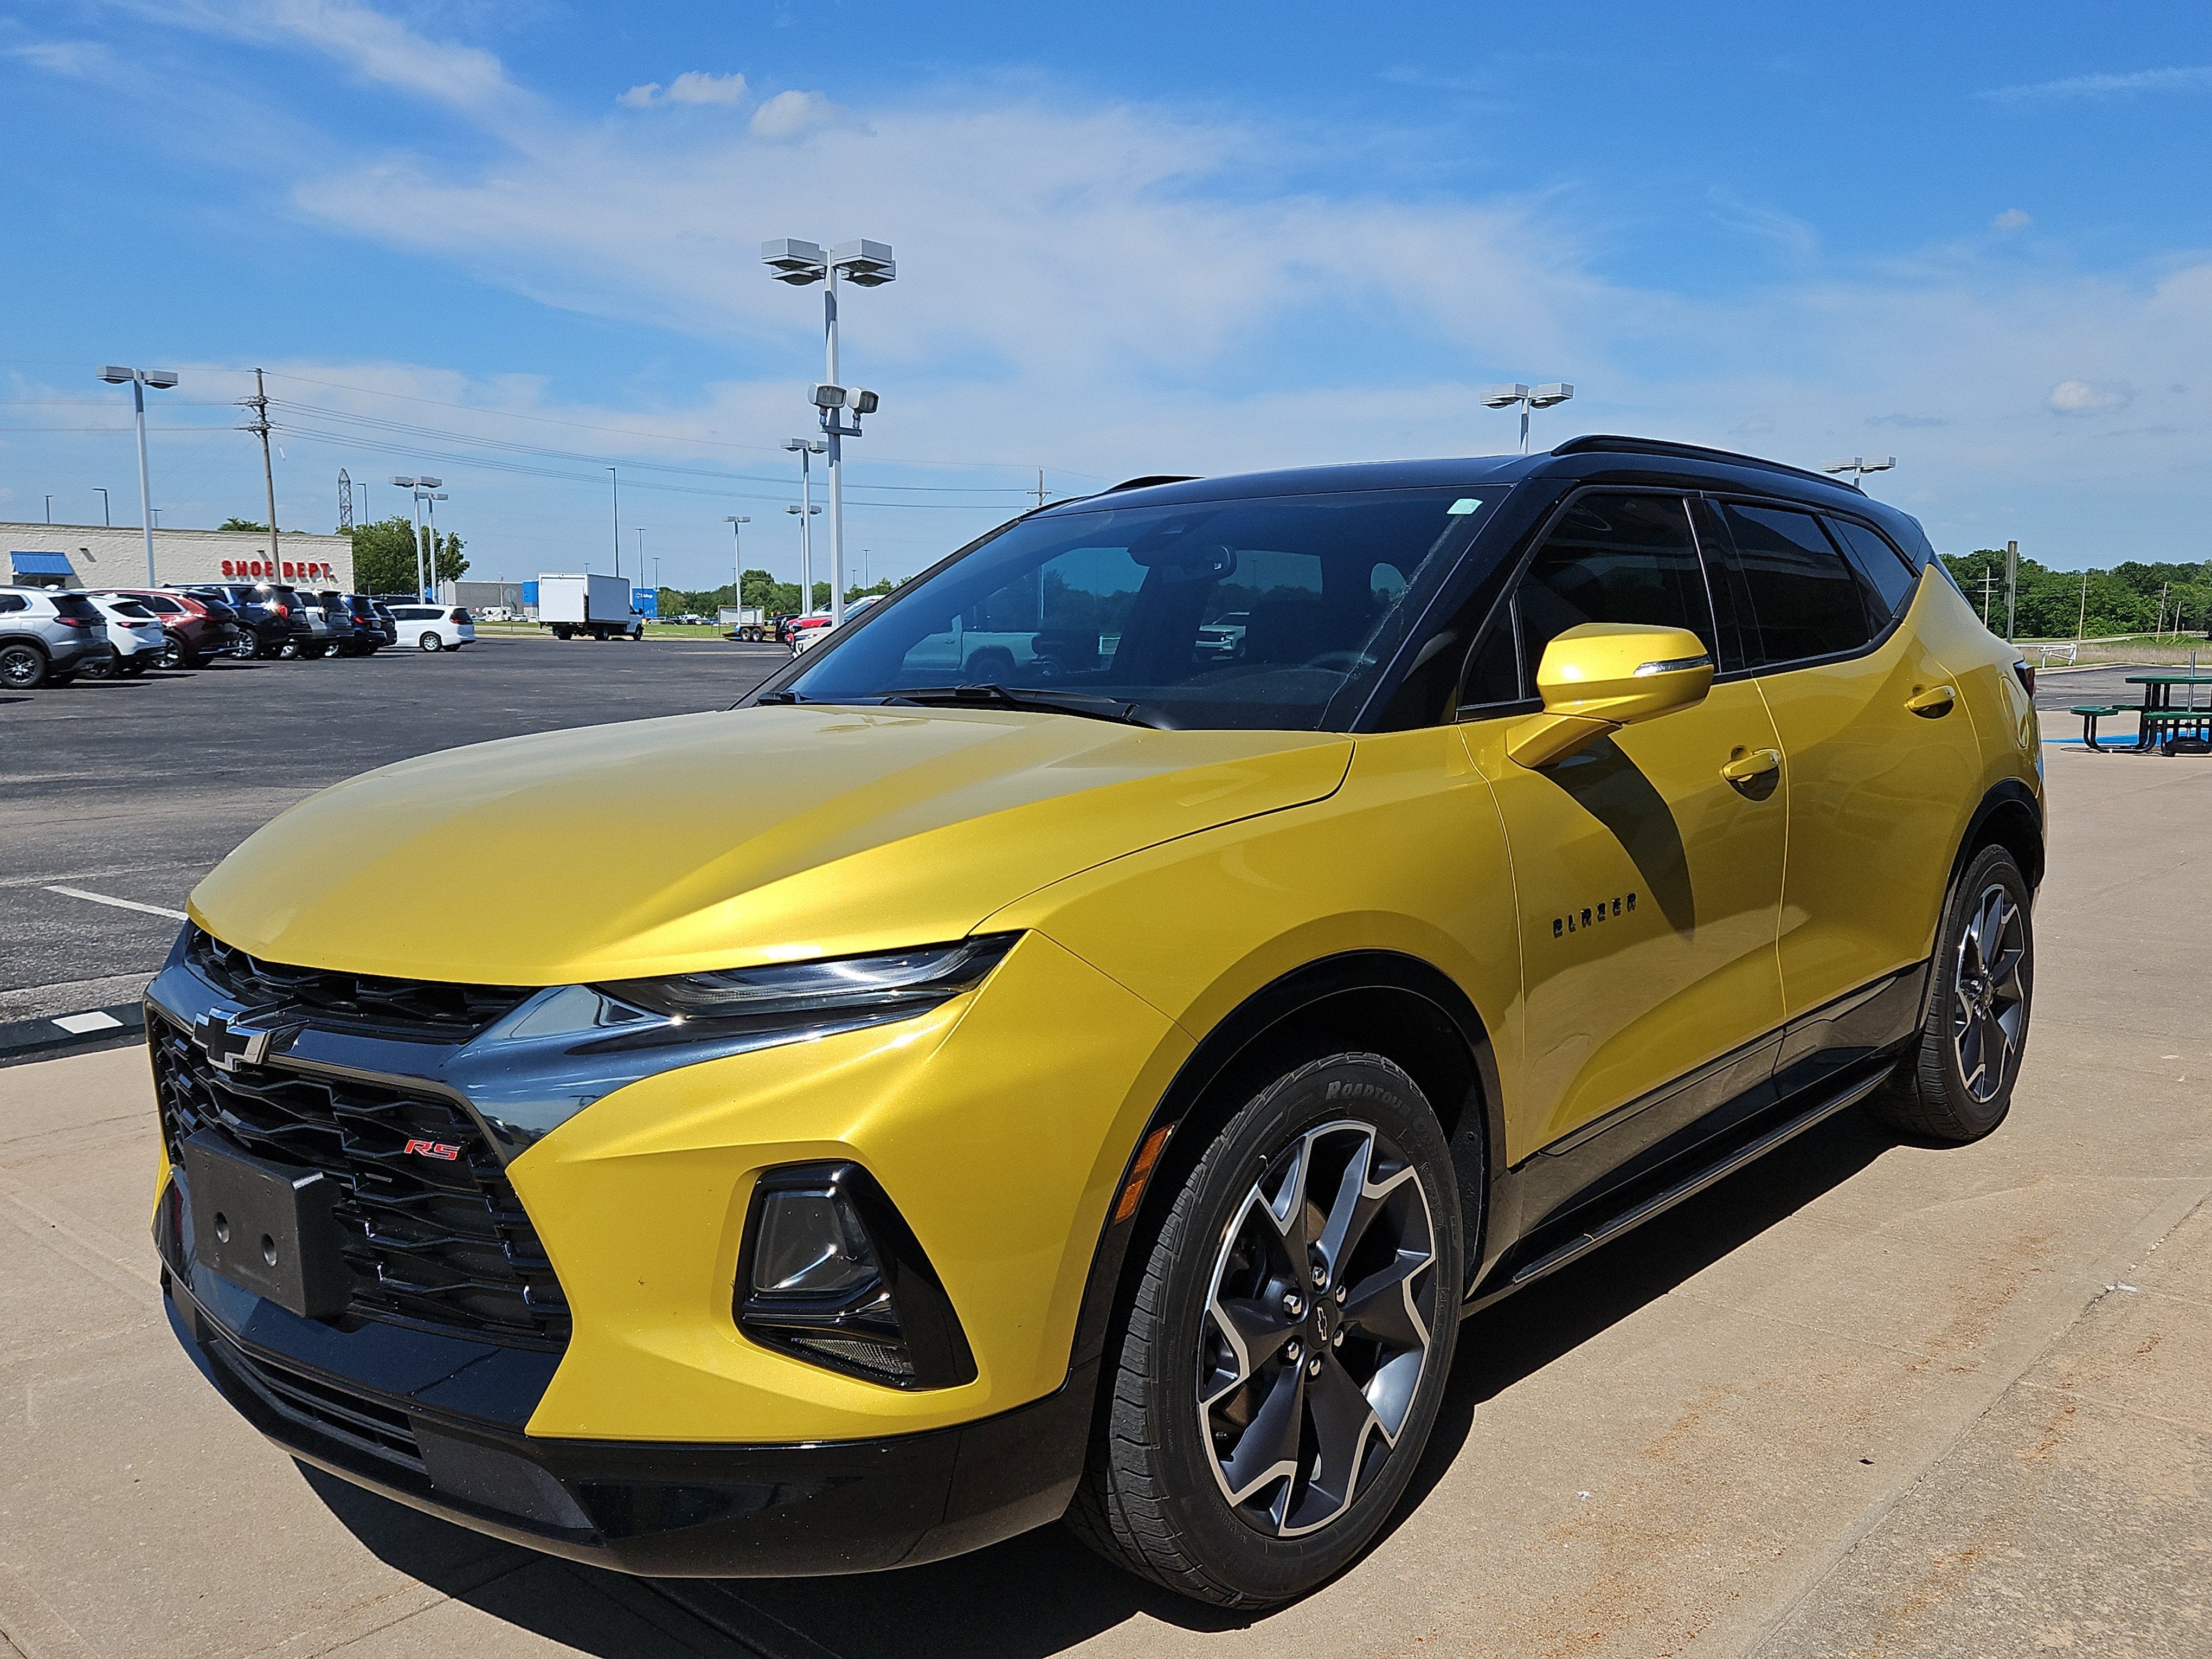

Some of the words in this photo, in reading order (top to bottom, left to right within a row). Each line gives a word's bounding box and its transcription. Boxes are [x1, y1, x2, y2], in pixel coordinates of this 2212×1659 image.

[221, 560, 274, 577] SHOE
[1552, 892, 1637, 938] BLAZER
[403, 1140, 461, 1160] RS
